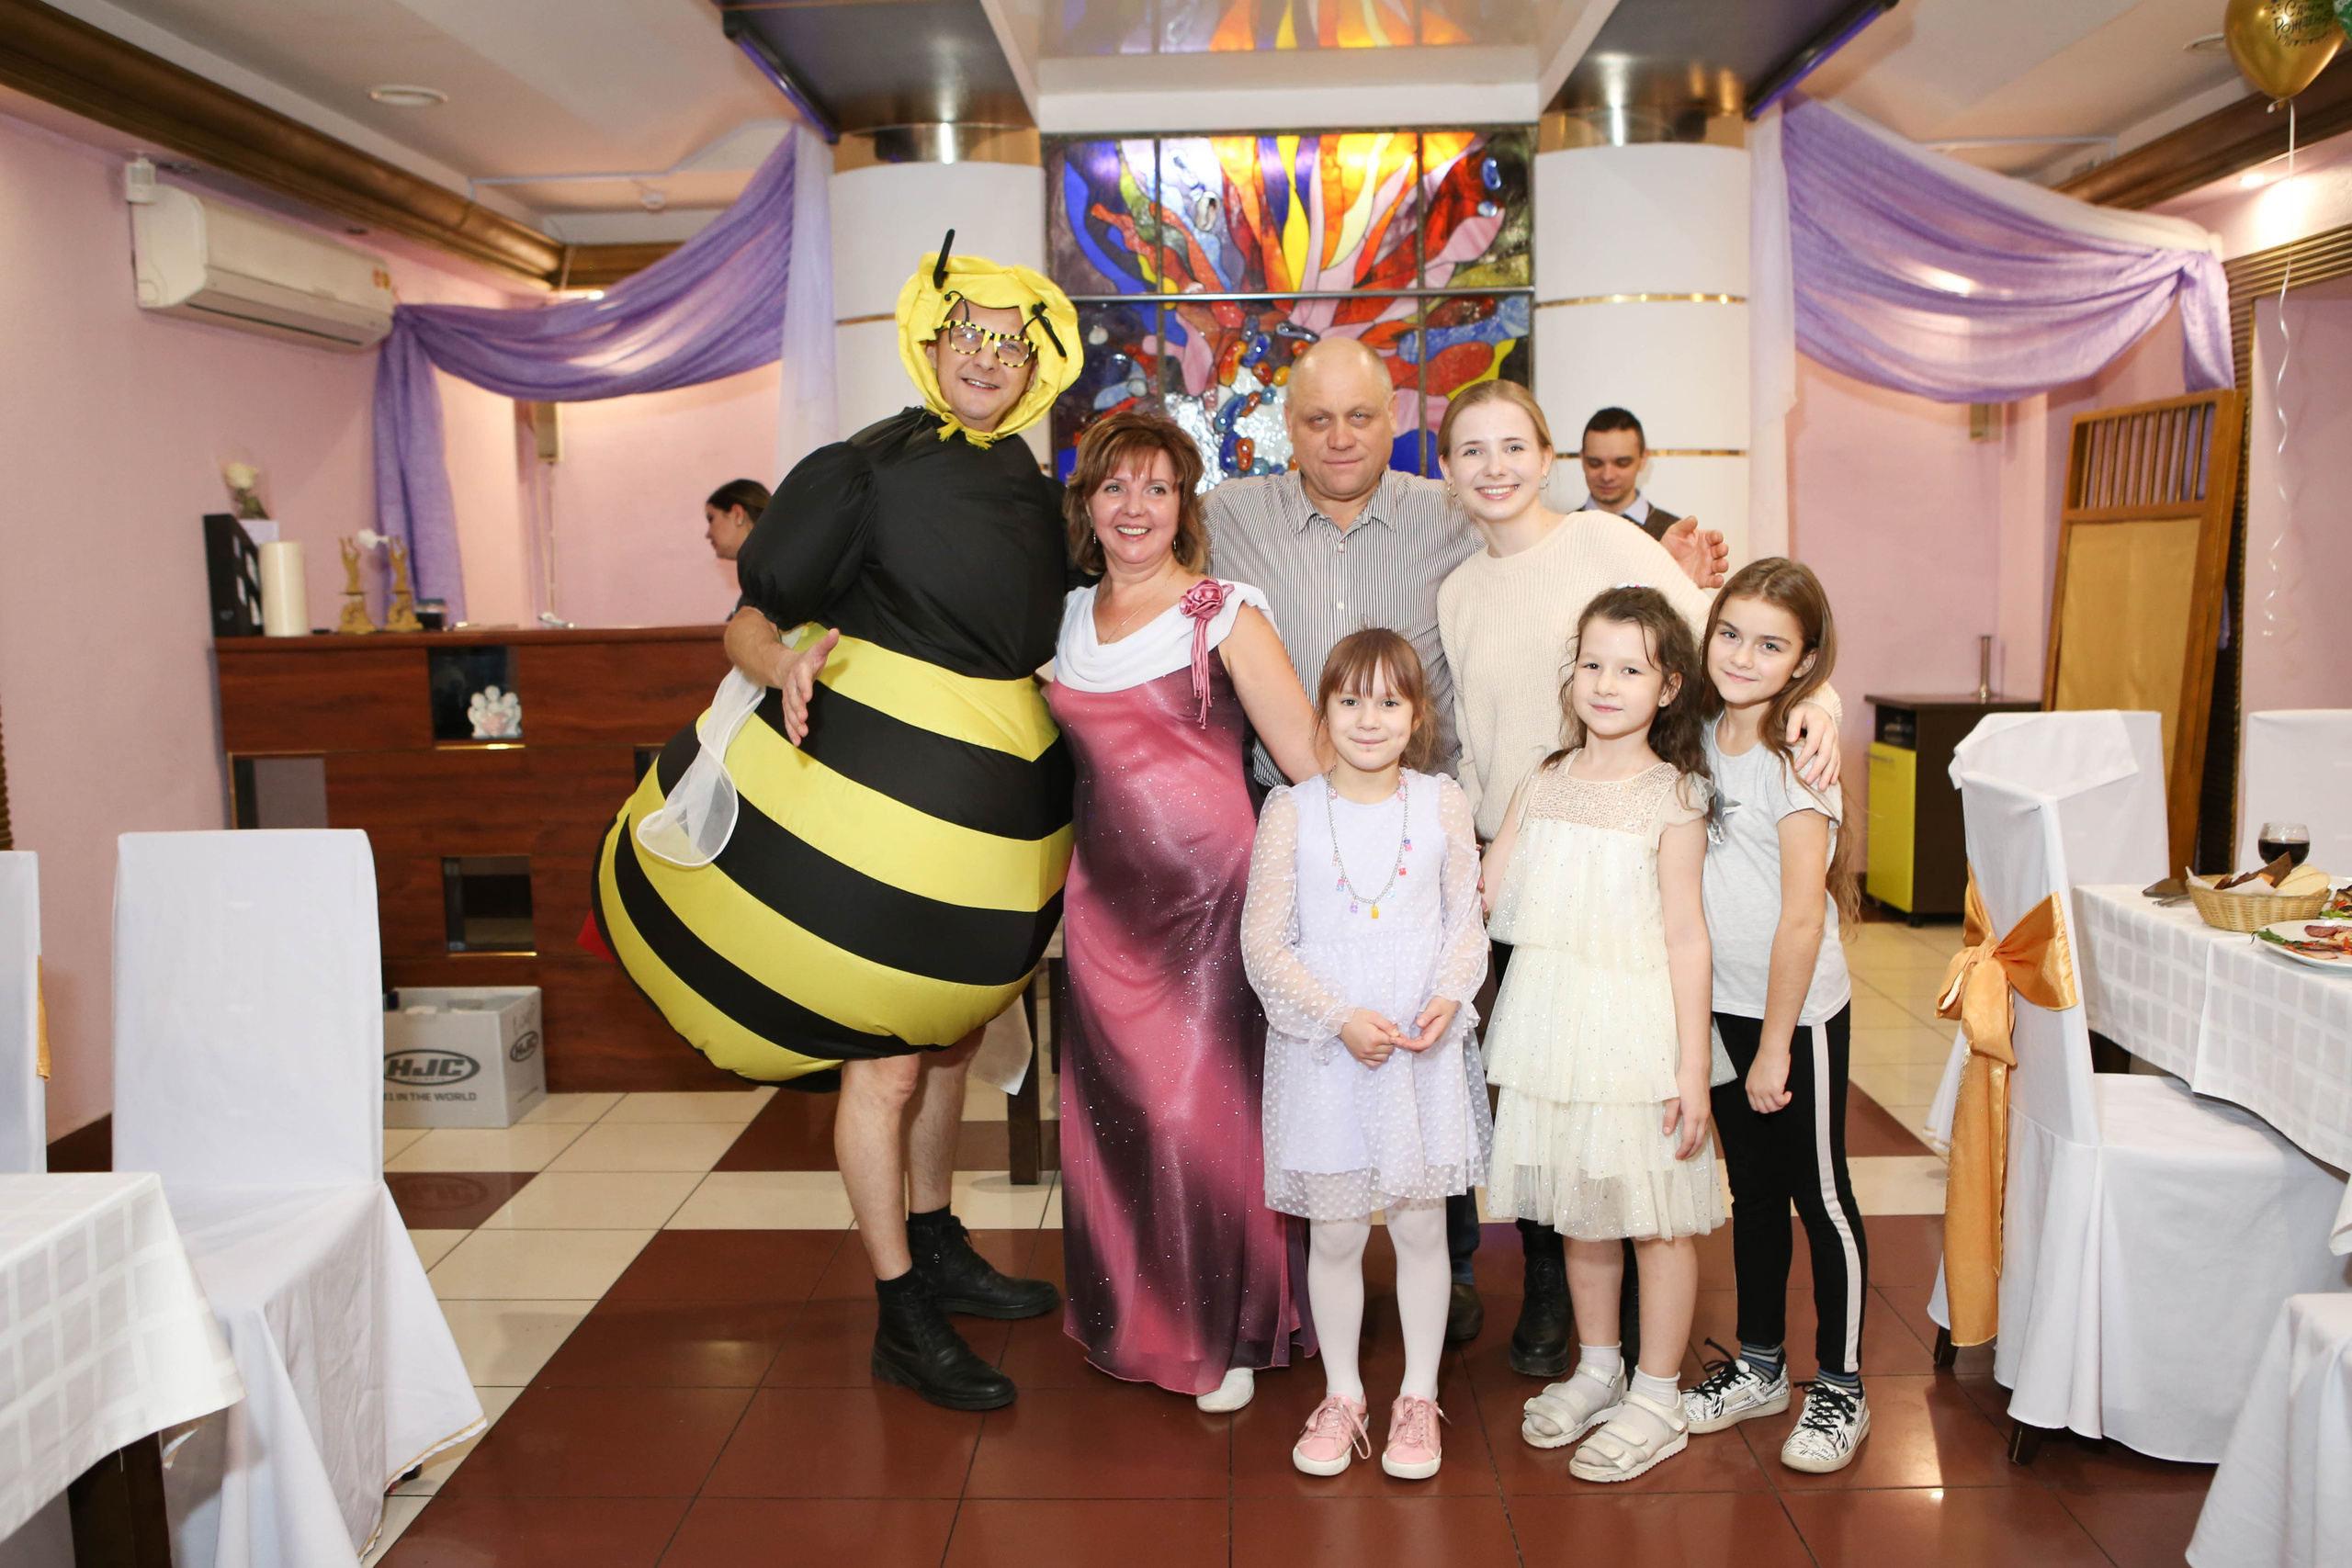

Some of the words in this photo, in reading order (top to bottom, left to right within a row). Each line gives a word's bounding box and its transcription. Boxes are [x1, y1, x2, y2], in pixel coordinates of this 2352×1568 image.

[387, 1059, 465, 1077] HJC
[396, 1092, 408, 1101] IN
[410, 1092, 431, 1101] THE
[434, 1092, 477, 1101] WORLD
